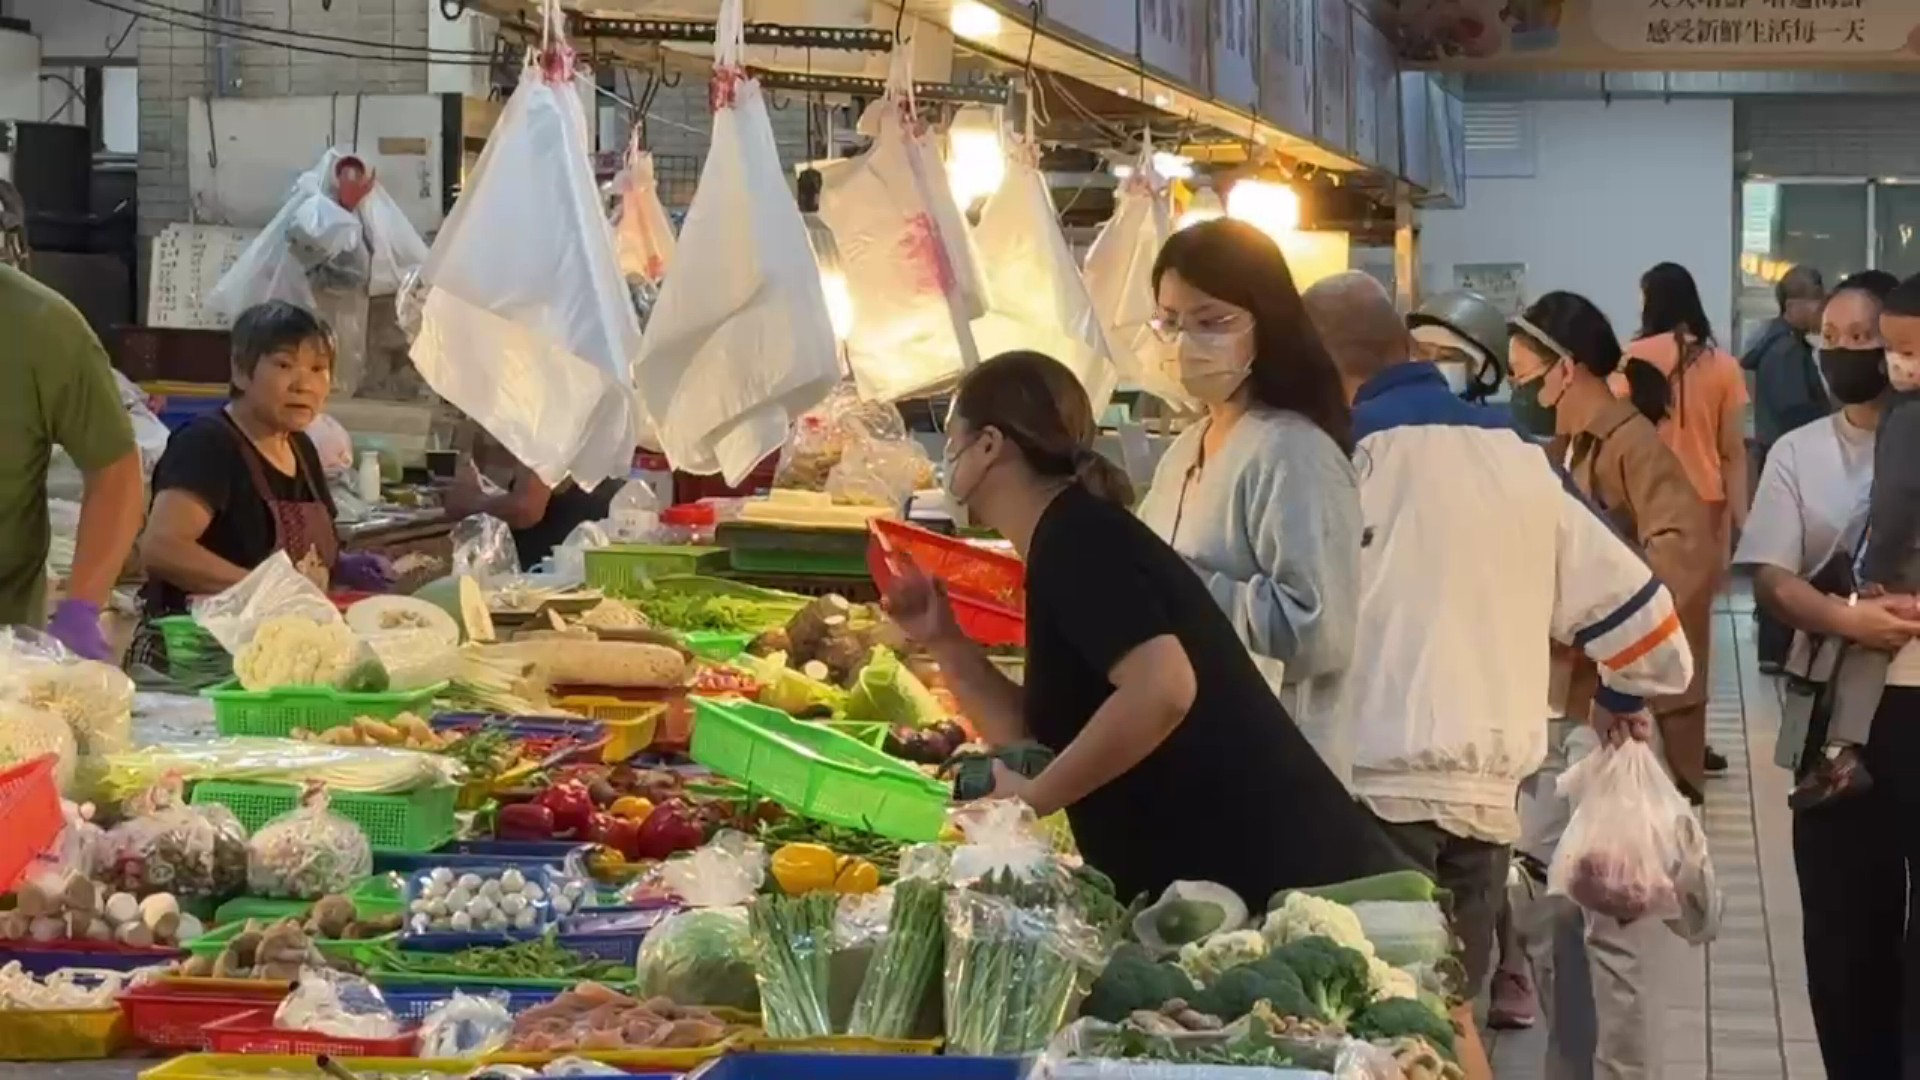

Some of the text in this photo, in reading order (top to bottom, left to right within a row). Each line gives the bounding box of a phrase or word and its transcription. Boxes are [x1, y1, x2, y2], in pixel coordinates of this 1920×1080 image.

[1645, 18, 1866, 44] 感受新鮮生活每一天
